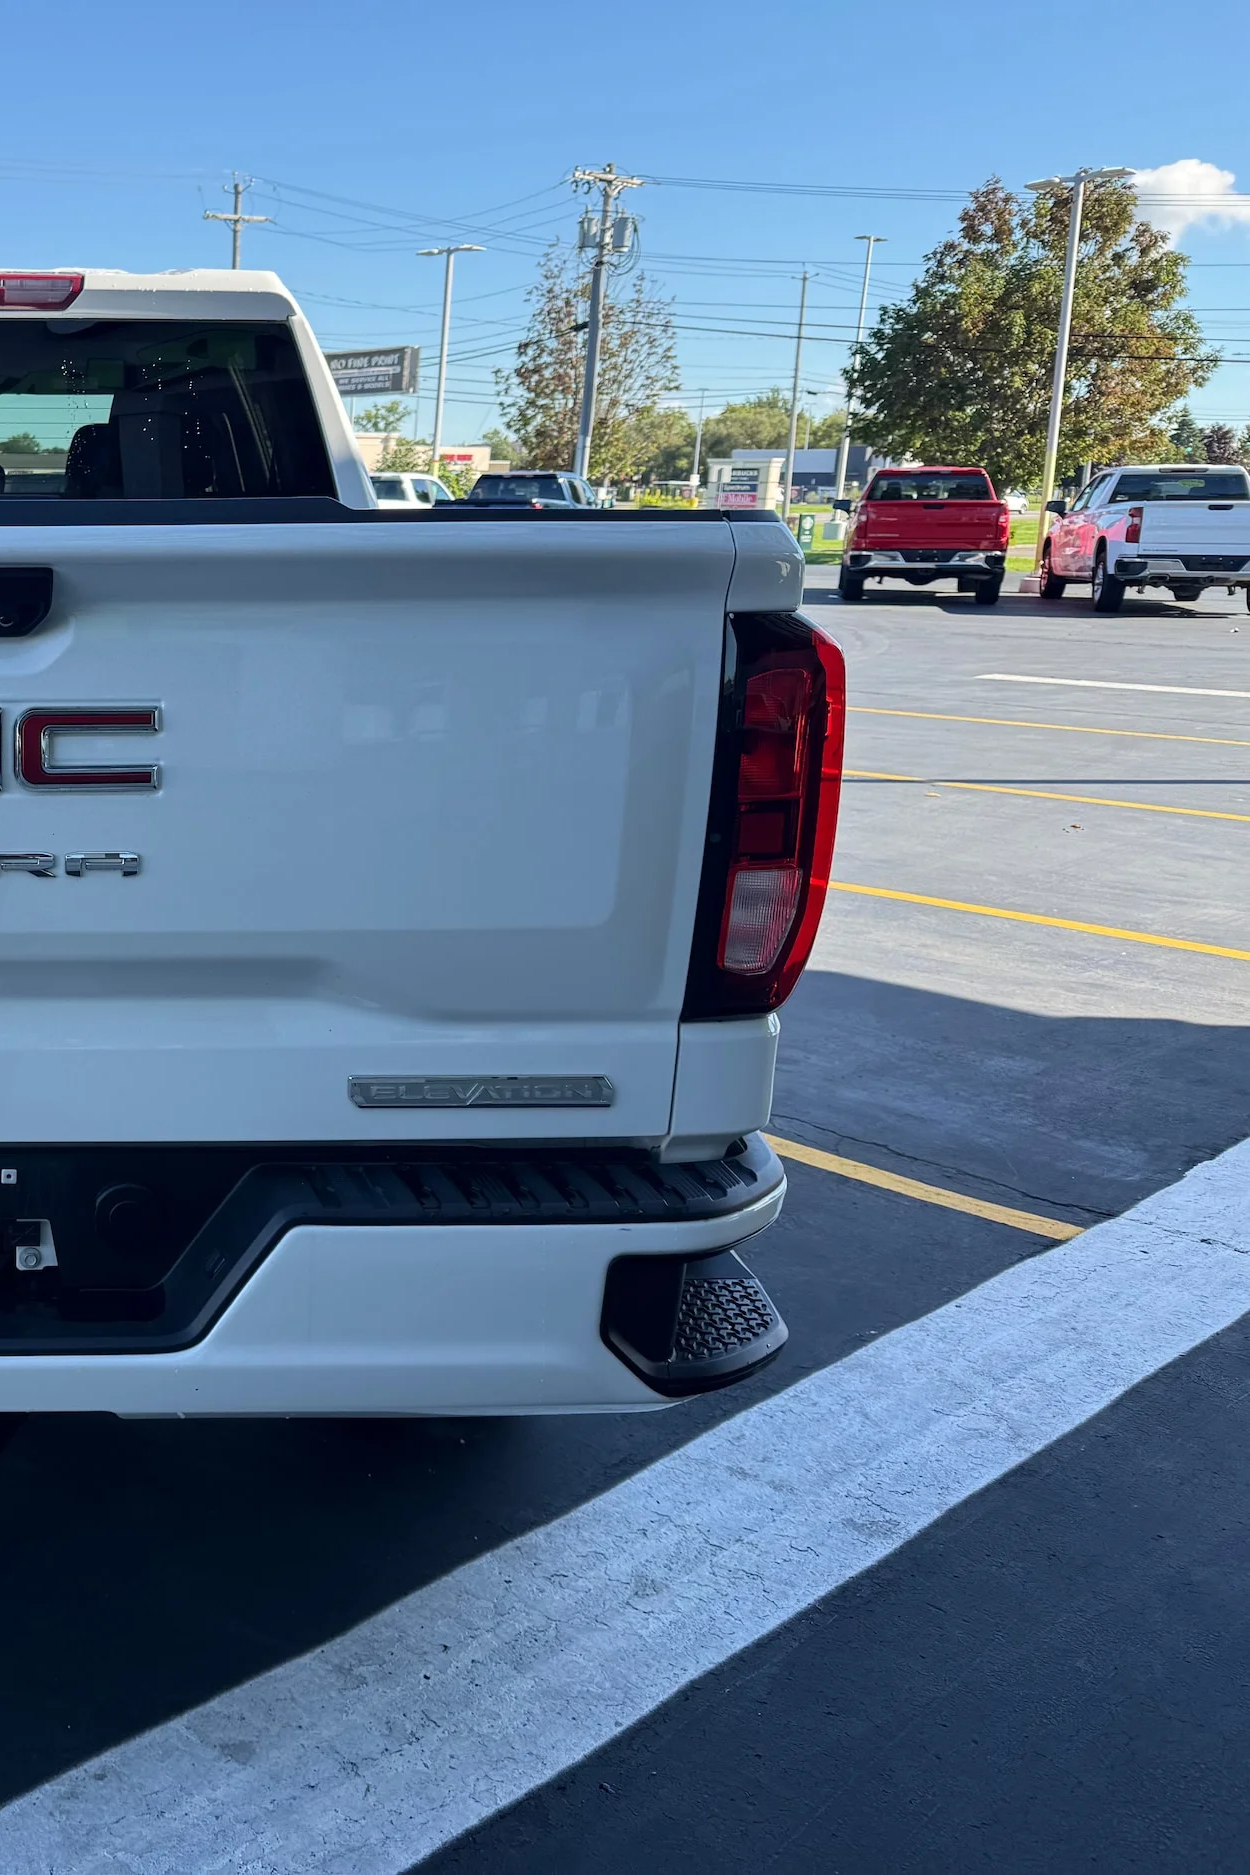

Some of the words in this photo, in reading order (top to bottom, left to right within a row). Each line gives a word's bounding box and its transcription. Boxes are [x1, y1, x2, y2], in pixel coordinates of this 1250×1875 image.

[347, 357, 370, 368] FINE
[371, 354, 400, 366] PRINT
[369, 1083, 593, 1101] ELEVATION
